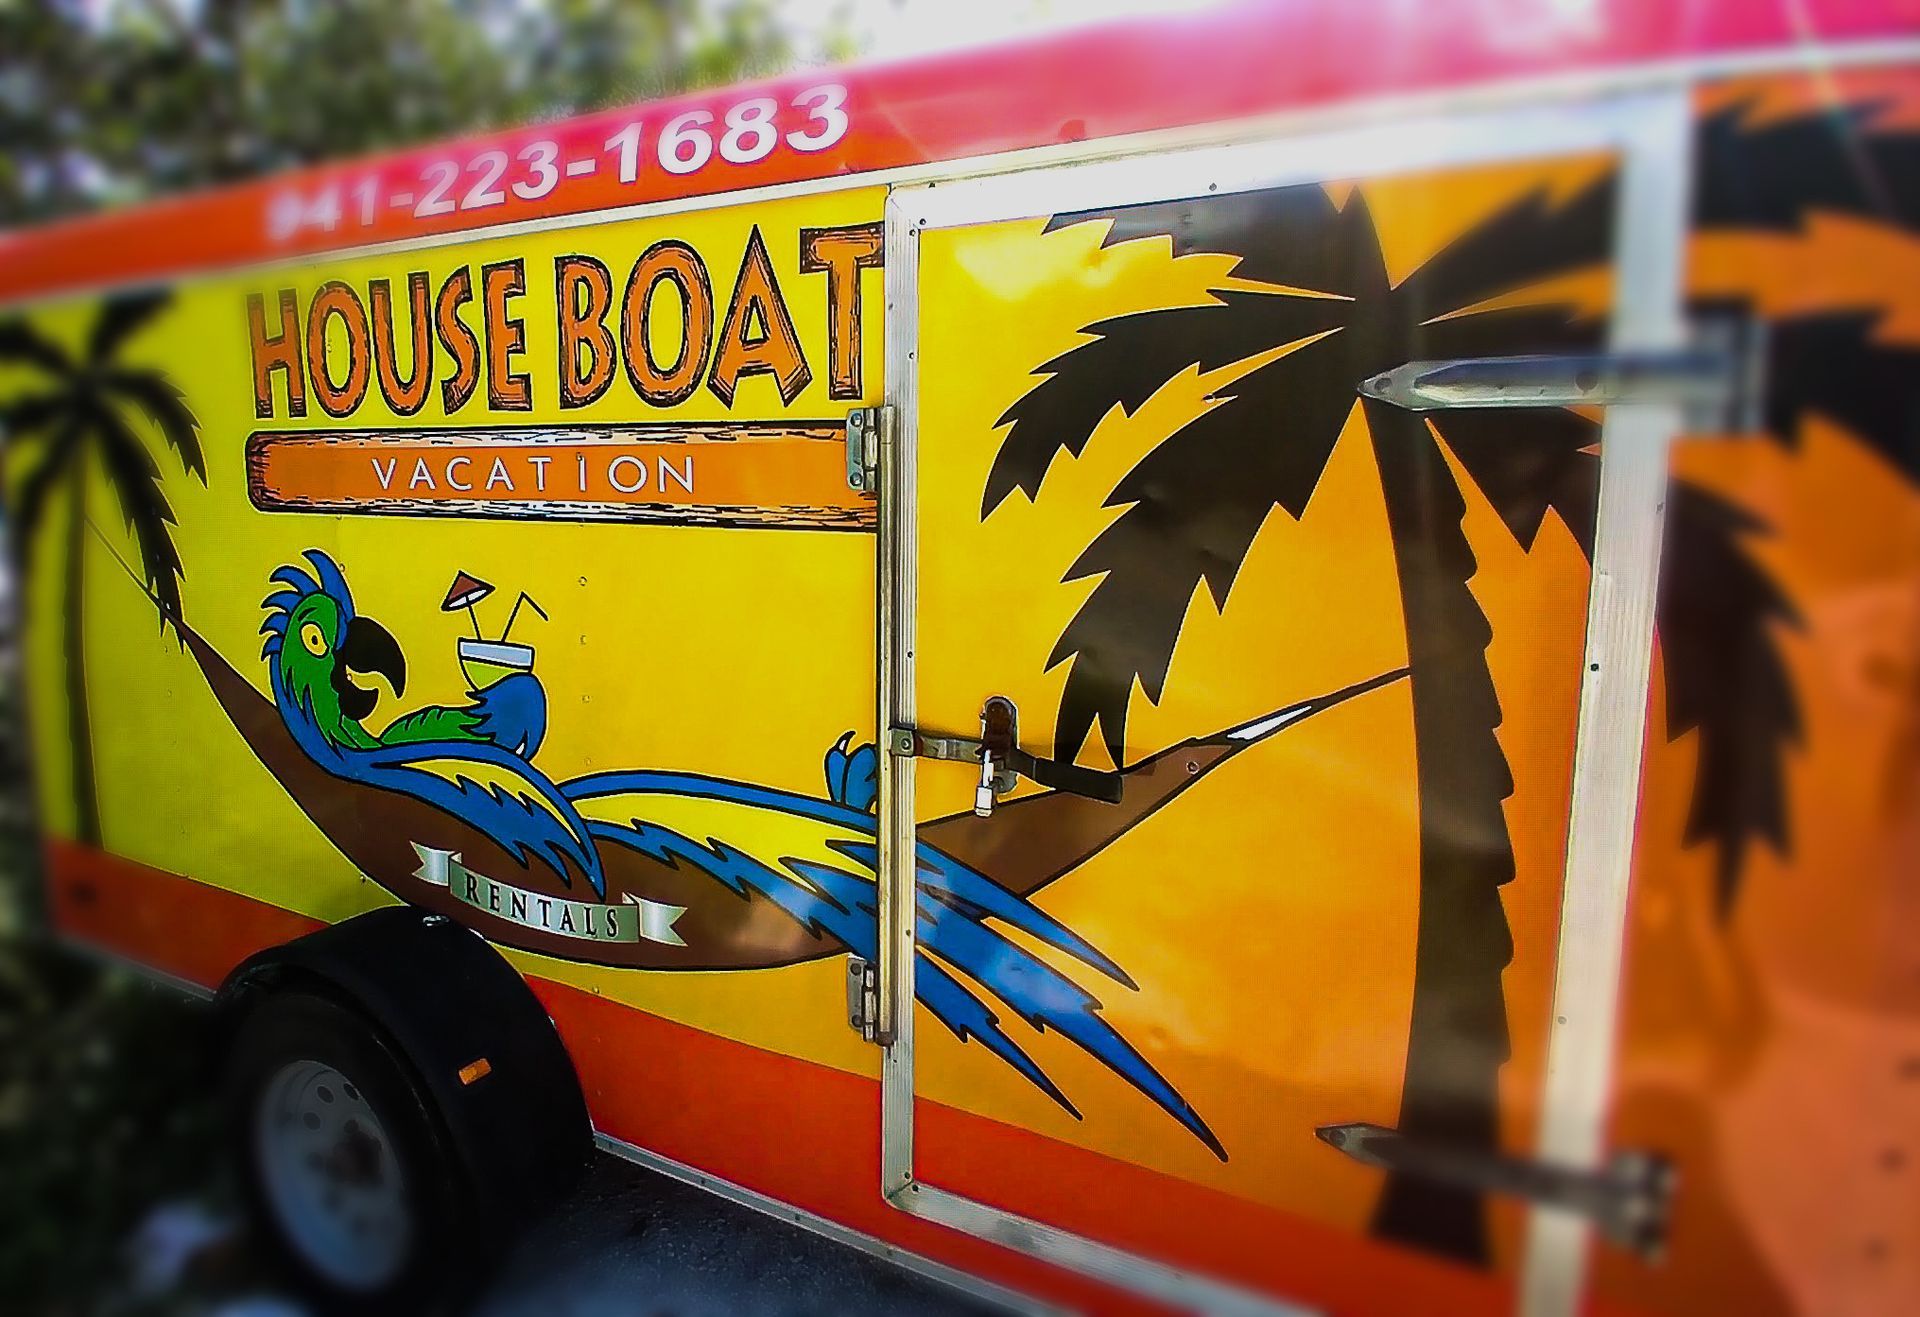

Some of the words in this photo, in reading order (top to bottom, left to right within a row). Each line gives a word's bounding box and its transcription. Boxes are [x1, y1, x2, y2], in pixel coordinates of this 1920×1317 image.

[268, 83, 850, 240] 941-223-1683
[248, 258, 534, 420] HOUSE
[554, 223, 884, 409] BOAT
[371, 454, 695, 494] VACATION
[464, 872, 618, 938] RENTALS
